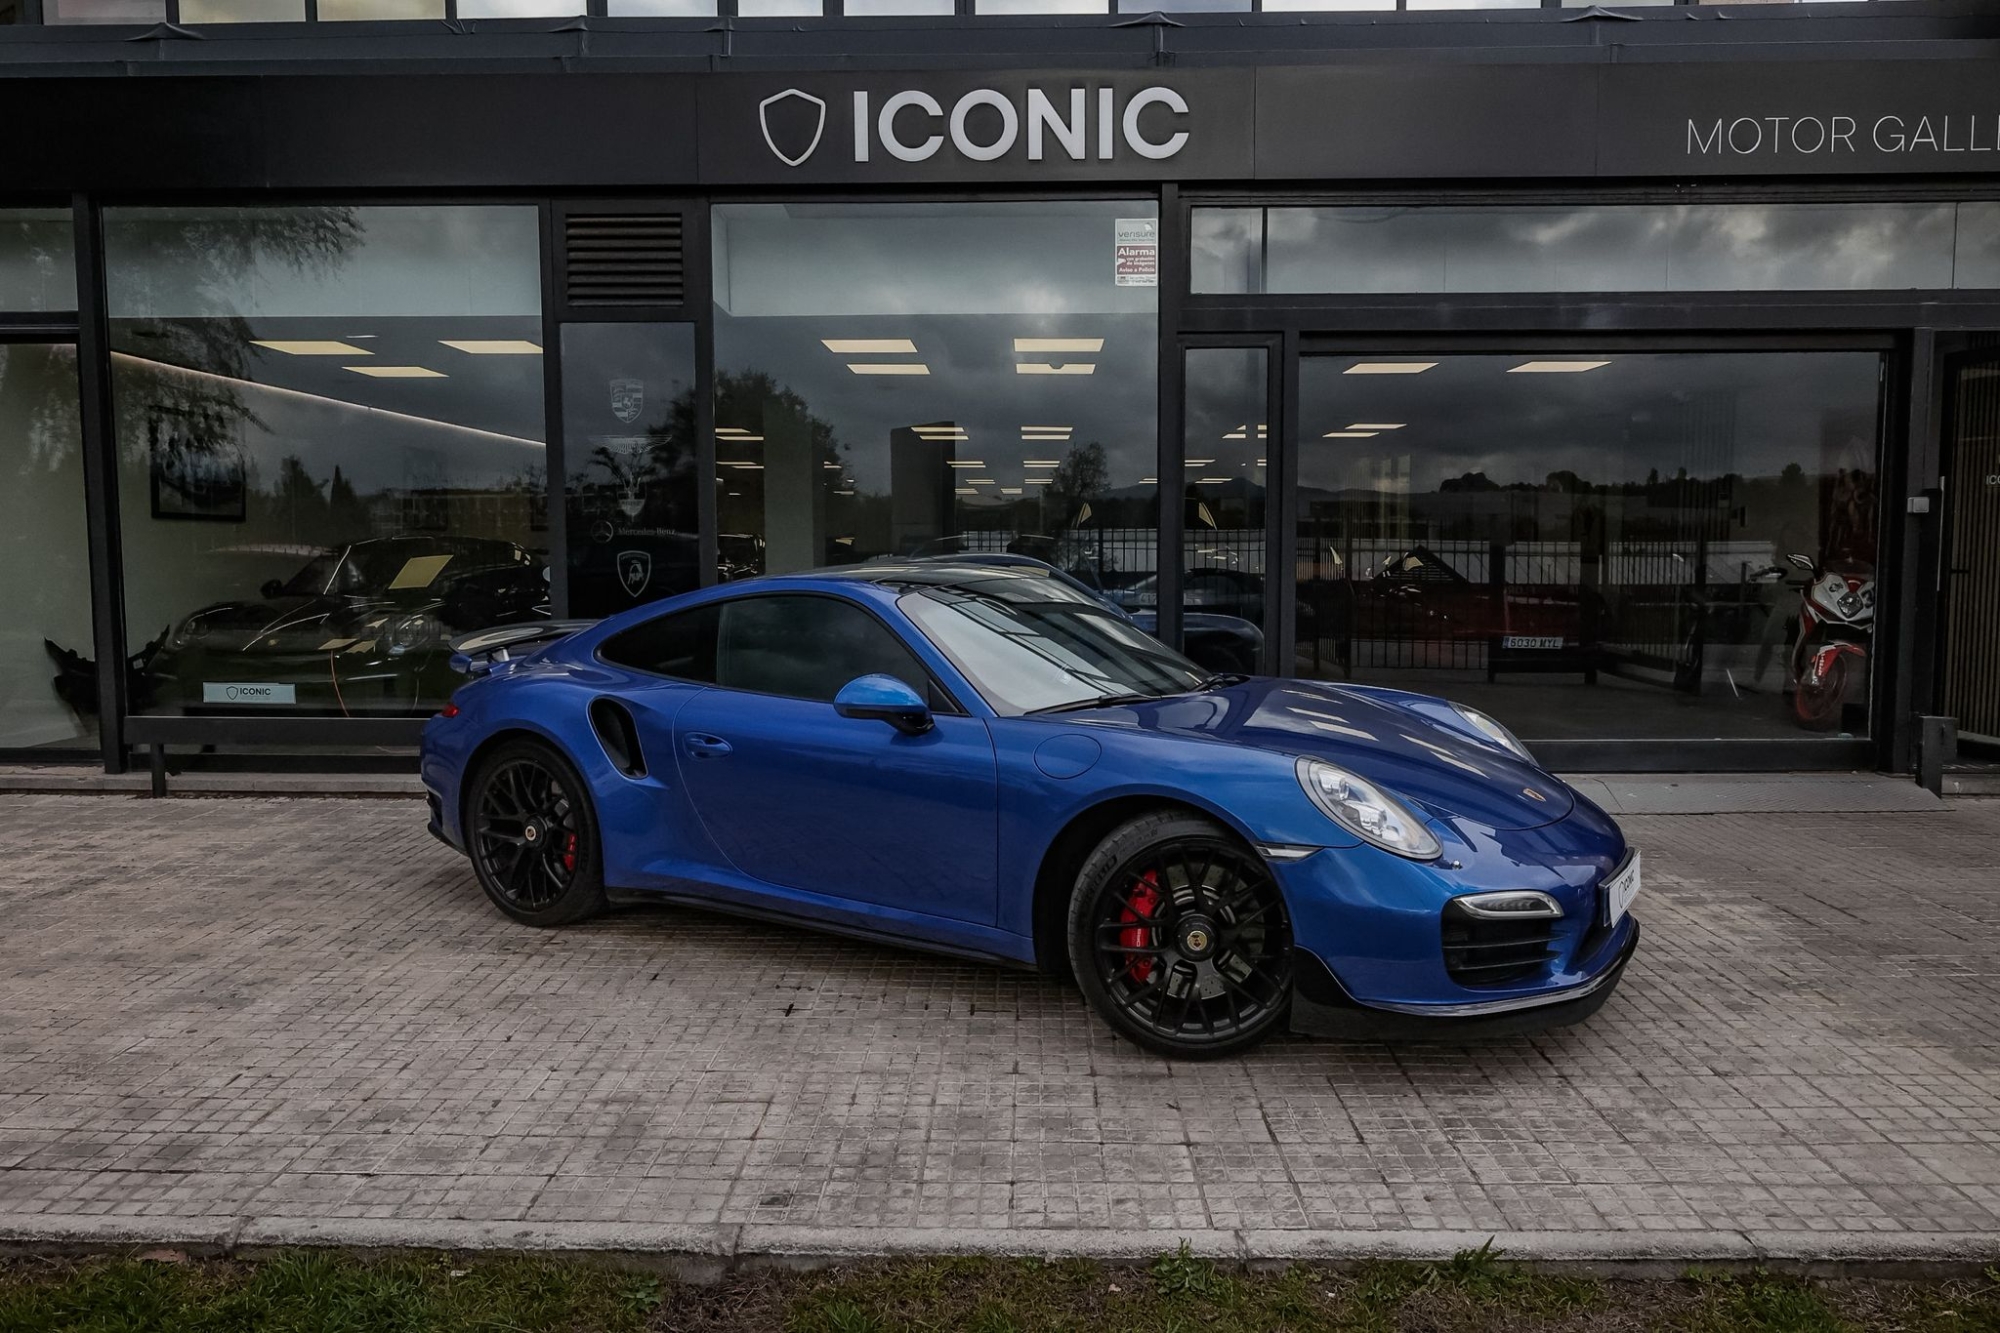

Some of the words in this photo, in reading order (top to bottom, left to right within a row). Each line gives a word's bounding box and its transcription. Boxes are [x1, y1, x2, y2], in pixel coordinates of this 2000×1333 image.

[853, 86, 1190, 162] ICONIC
[1687, 116, 1856, 154] MOTOR
[1118, 247, 1155, 256] Alarma
[240, 687, 271, 695] ICONIC
